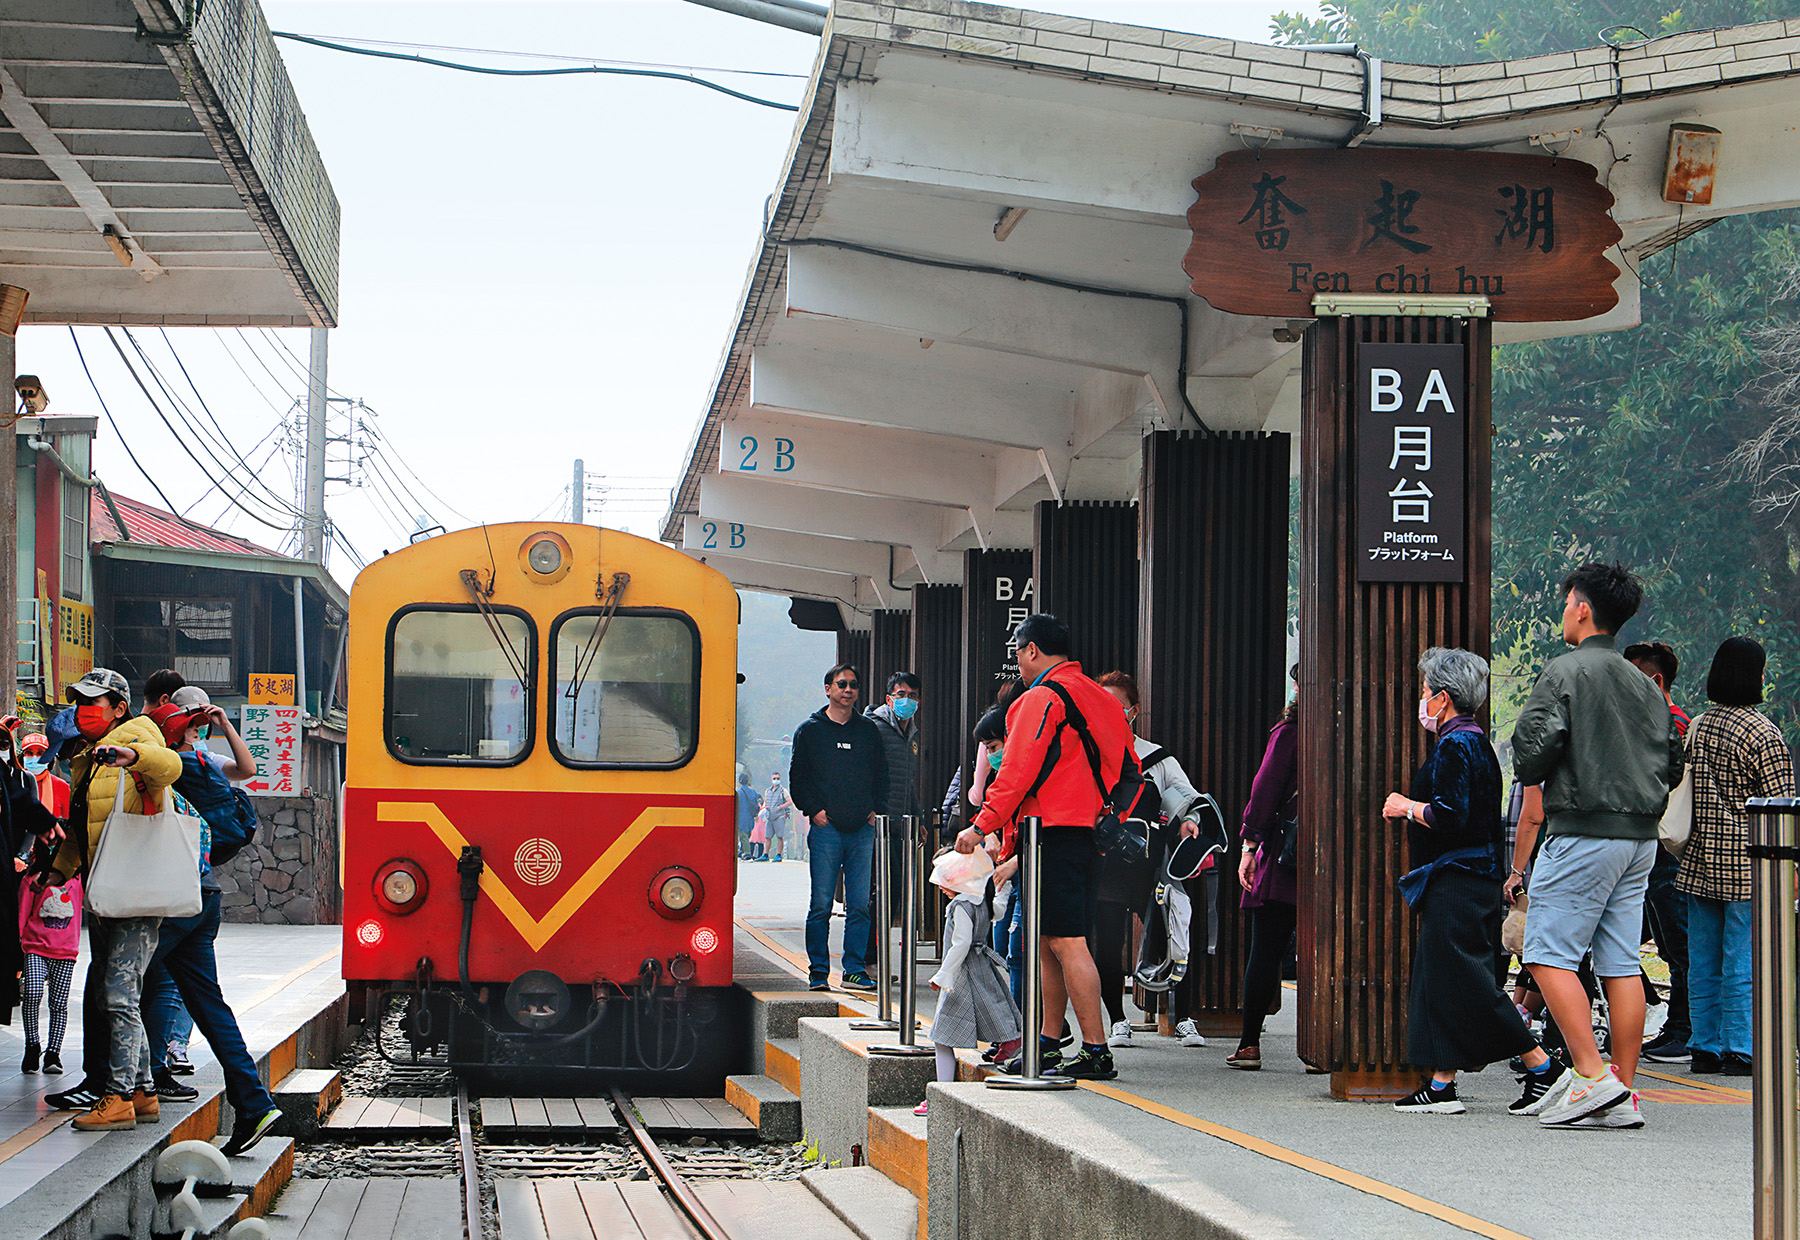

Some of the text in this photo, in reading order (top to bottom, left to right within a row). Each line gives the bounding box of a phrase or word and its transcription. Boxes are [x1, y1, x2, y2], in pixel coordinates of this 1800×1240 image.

[1238, 171, 1555, 254] 奮起湖
[1288, 262, 1506, 296] Fen chi hu
[1388, 426, 1434, 523] 月台
[1383, 532, 1438, 543] Platform
[1368, 548, 1454, 560] プラットフォーム
[251, 677, 293, 696] 奮起湖
